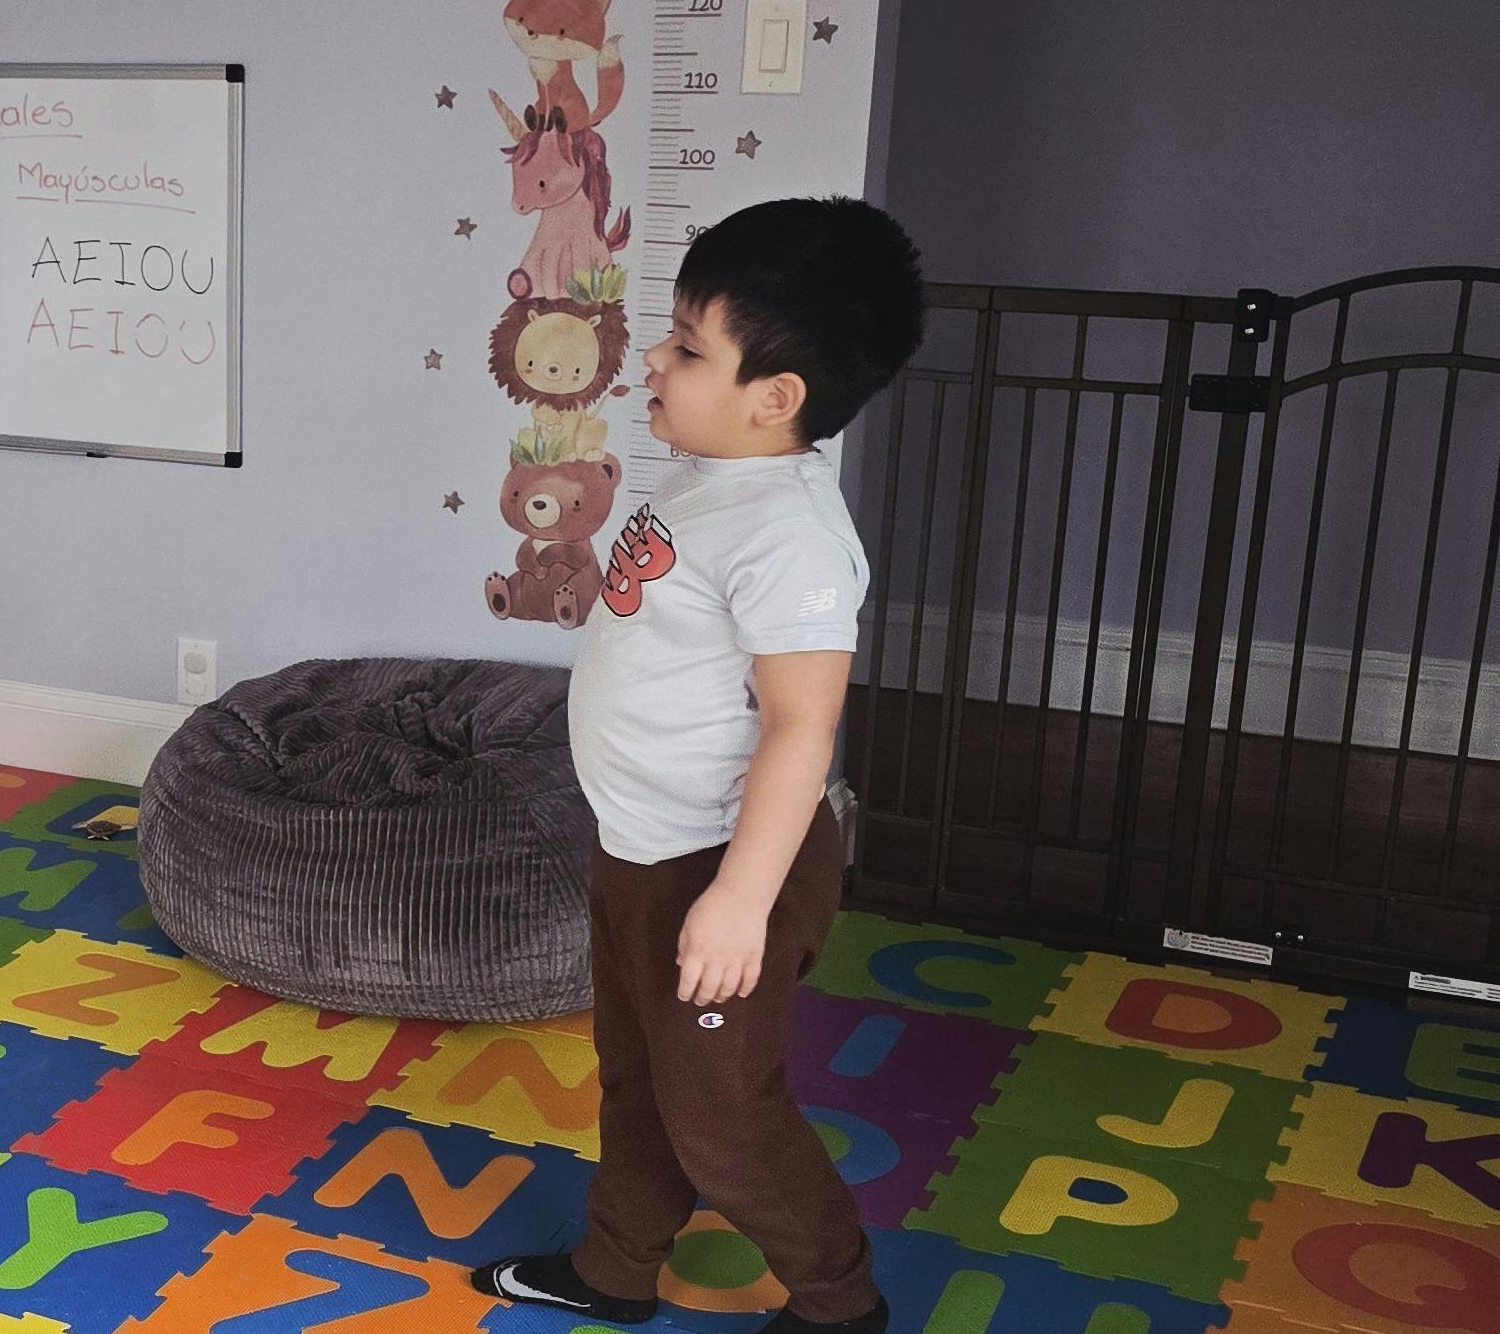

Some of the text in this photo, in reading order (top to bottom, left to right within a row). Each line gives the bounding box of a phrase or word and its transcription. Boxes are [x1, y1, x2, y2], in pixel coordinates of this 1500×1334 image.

[684, 72, 718, 89] 110
[18, 161, 186, 204] Mayúsculas
[679, 148, 716, 165] 100
[11, 953, 182, 1026] Z
[867, 939, 1017, 1007] C
[1104, 978, 1283, 1050] D
[110, 1089, 275, 1166] F
[1095, 1077, 1235, 1148] J
[313, 1127, 536, 1240] N
[999, 1154, 1180, 1236] P
